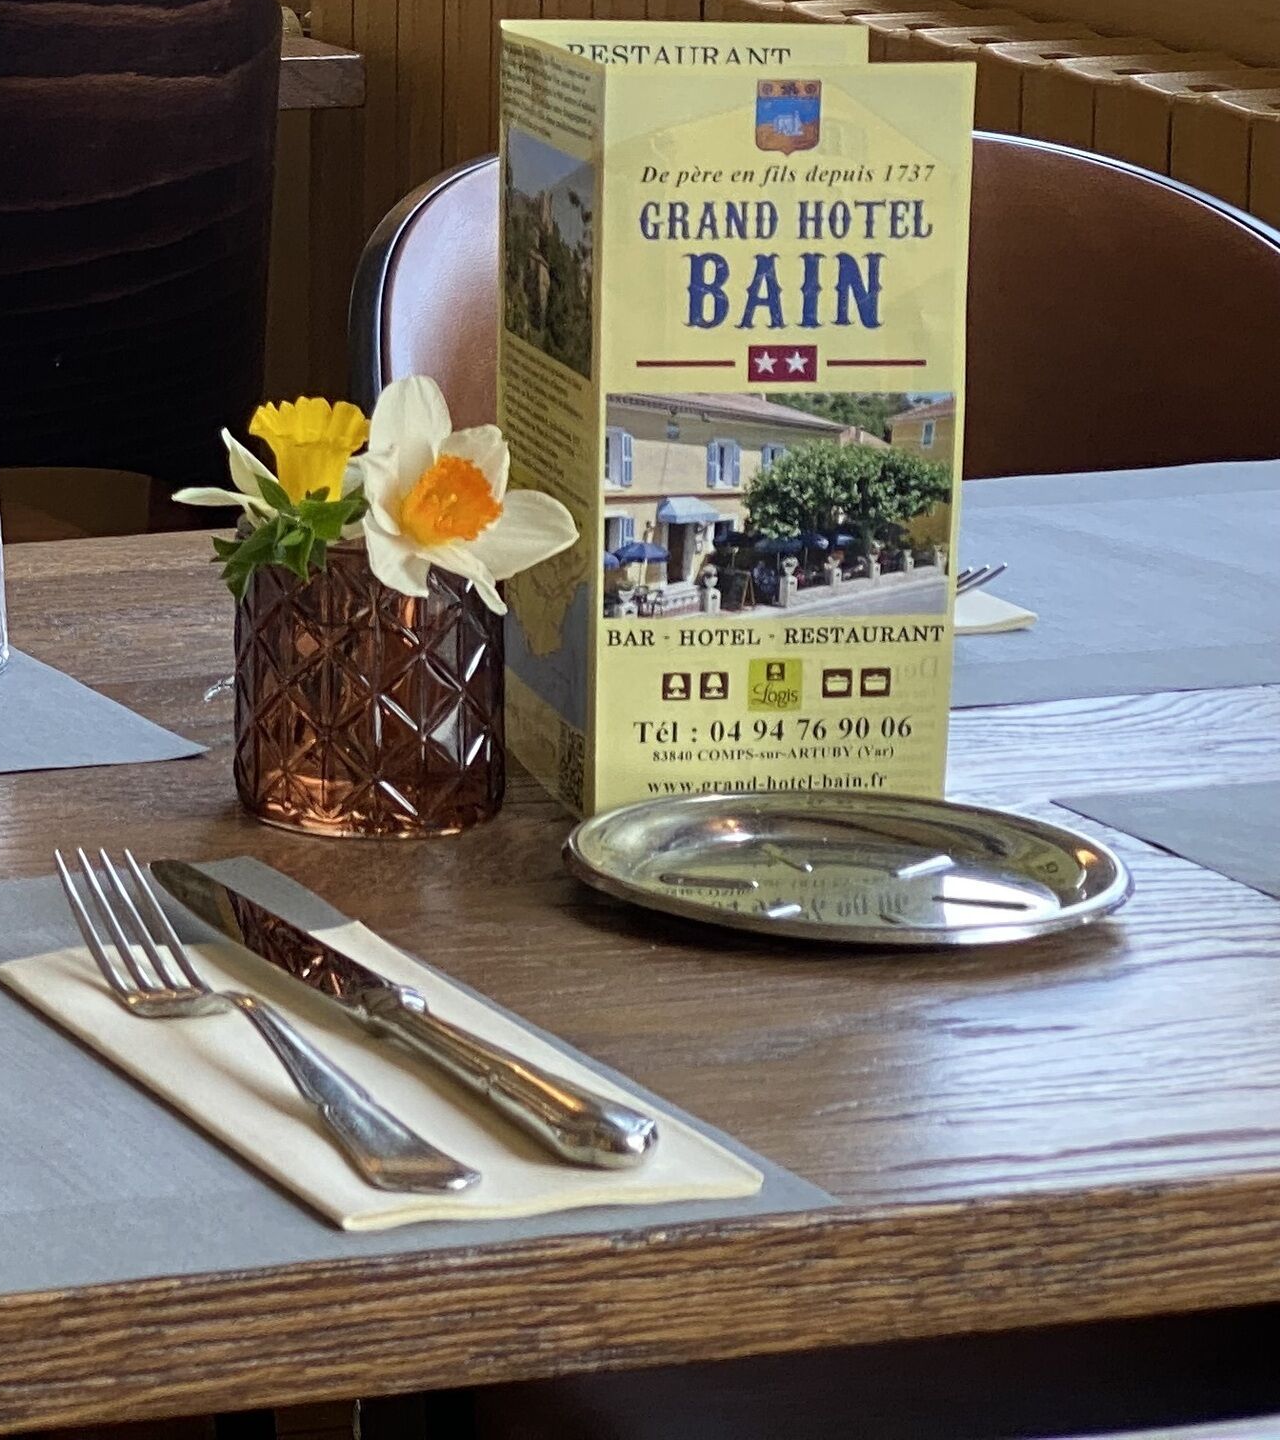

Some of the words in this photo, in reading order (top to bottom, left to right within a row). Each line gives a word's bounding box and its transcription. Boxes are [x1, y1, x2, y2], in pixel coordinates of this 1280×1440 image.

[640, 165, 670, 183] De
[675, 164, 723, 188] père
[730, 169, 755, 183] en
[758, 165, 797, 188] fils
[805, 165, 876, 187] depuis
[884, 163, 936, 183] 1737
[639, 200, 779, 240] GRAND
[796, 199, 934, 240] HOTEL
[682, 251, 889, 330] BAIN
[606, 628, 656, 647] BAR
[679, 628, 761, 646] HOTEL
[784, 625, 946, 645] RESTAURANT
[751, 681, 799, 708] Logis
[633, 719, 679, 744] Tél
[710, 719, 742, 742] 04
[753, 718, 785, 741] 94
[797, 717, 828, 741] 76
[839, 716, 871, 740] 90
[880, 714, 913, 739] 06
[651, 749, 693, 763] 83840
[858, 744, 895, 760] (Var)
